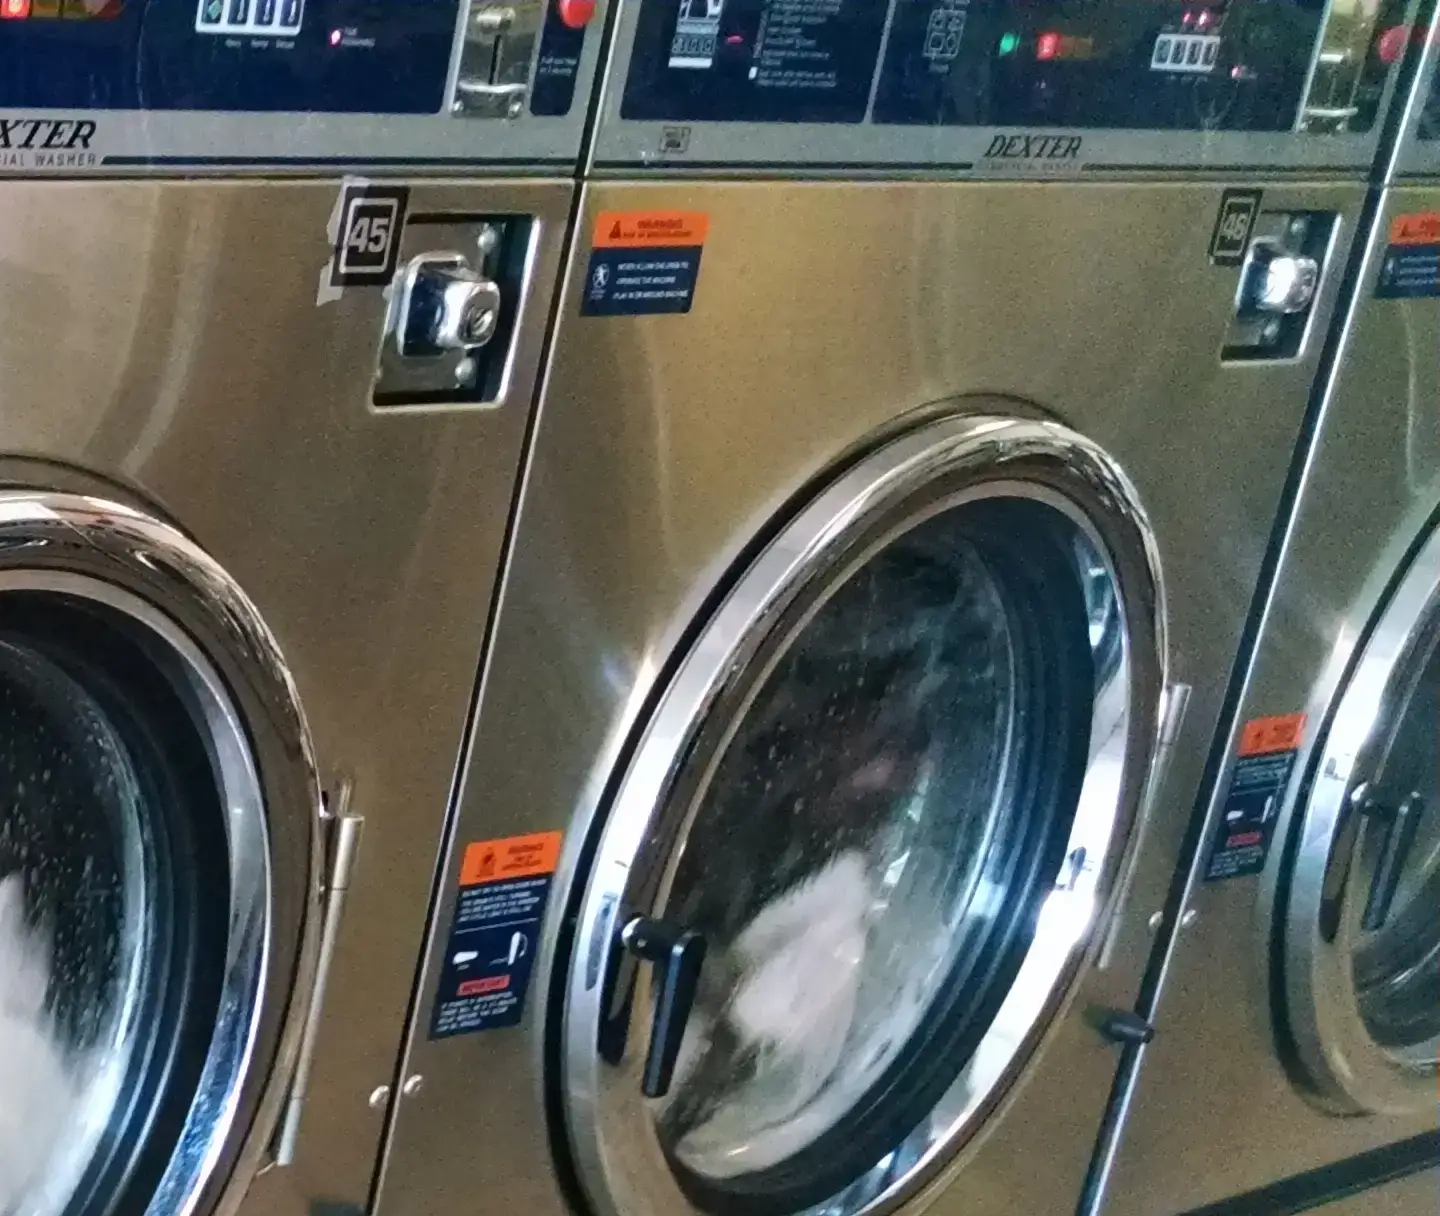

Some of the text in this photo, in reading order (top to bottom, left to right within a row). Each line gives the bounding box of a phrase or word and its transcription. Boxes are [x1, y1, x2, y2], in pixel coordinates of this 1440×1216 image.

[982, 134, 1083, 159] DEXTER
[35, 153, 97, 167] WASHER
[347, 216, 389, 253] 45
